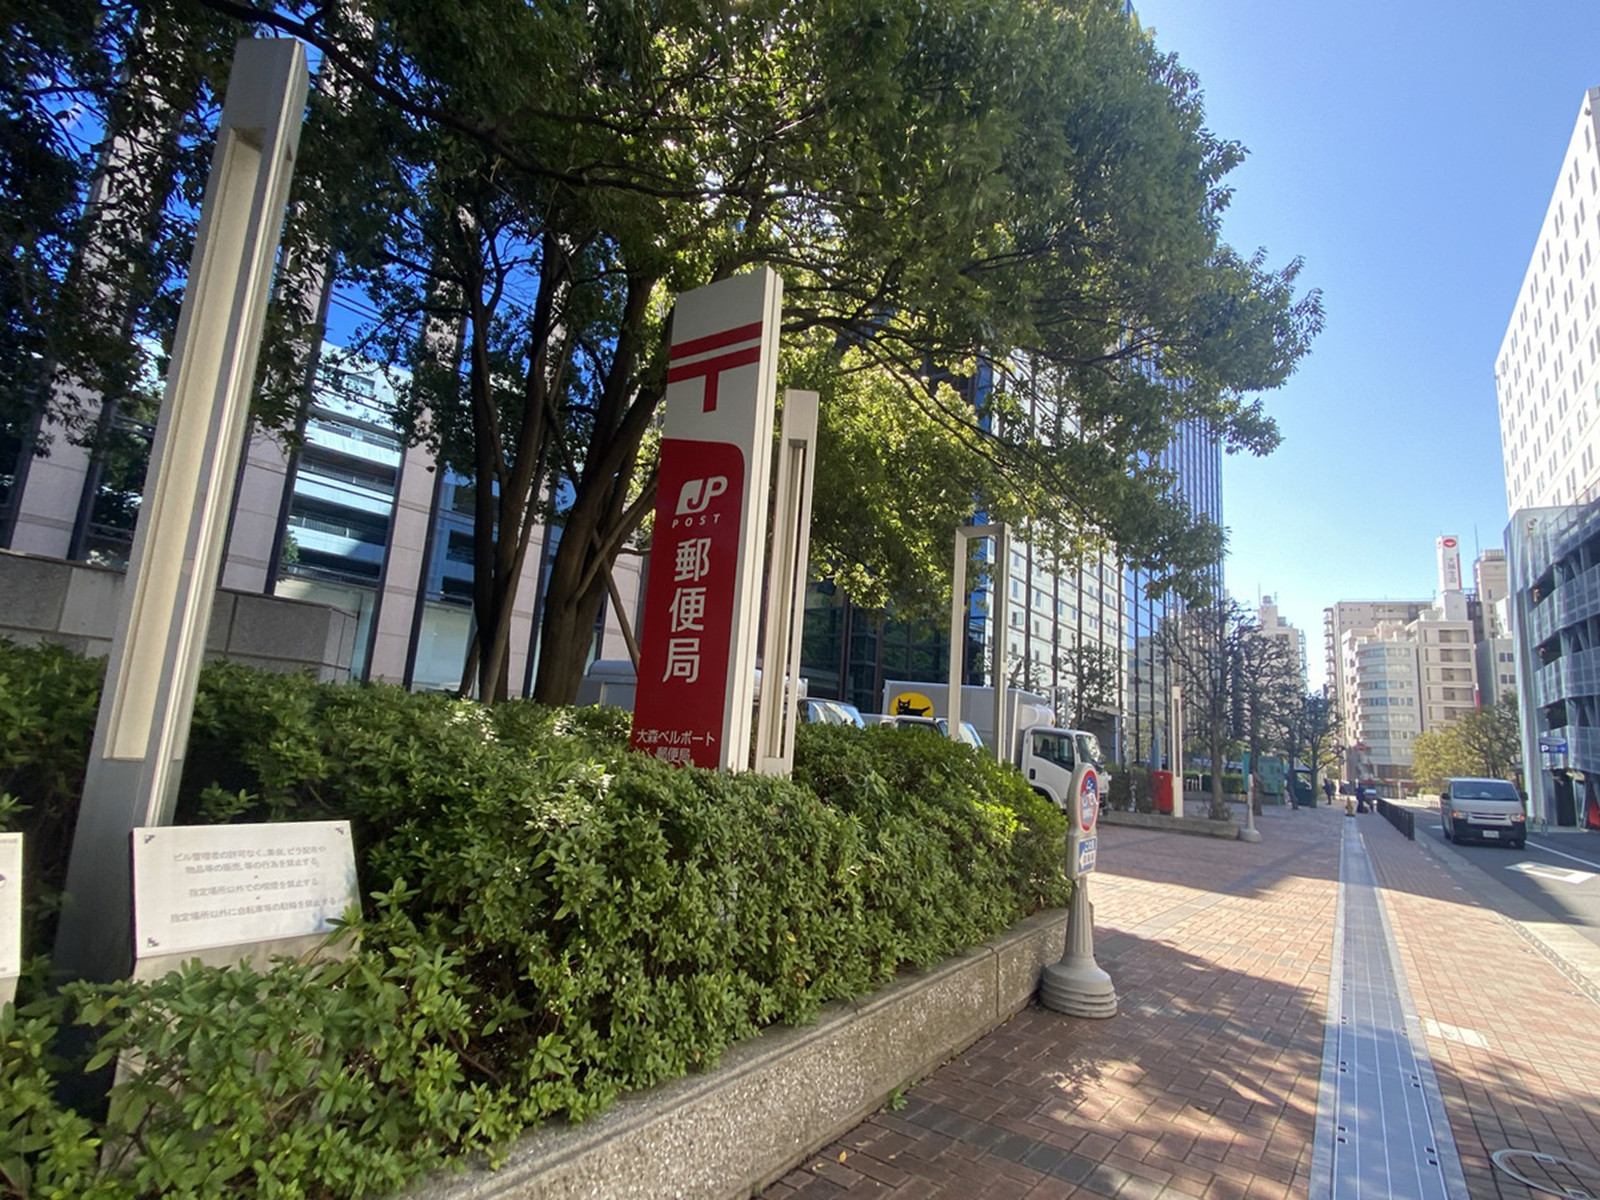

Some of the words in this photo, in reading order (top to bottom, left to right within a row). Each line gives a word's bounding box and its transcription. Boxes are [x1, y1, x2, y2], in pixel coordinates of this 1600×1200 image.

[671, 513, 721, 529] POST
[662, 537, 712, 684] 郵便局
[636, 728, 715, 746] 大森ベルポート
